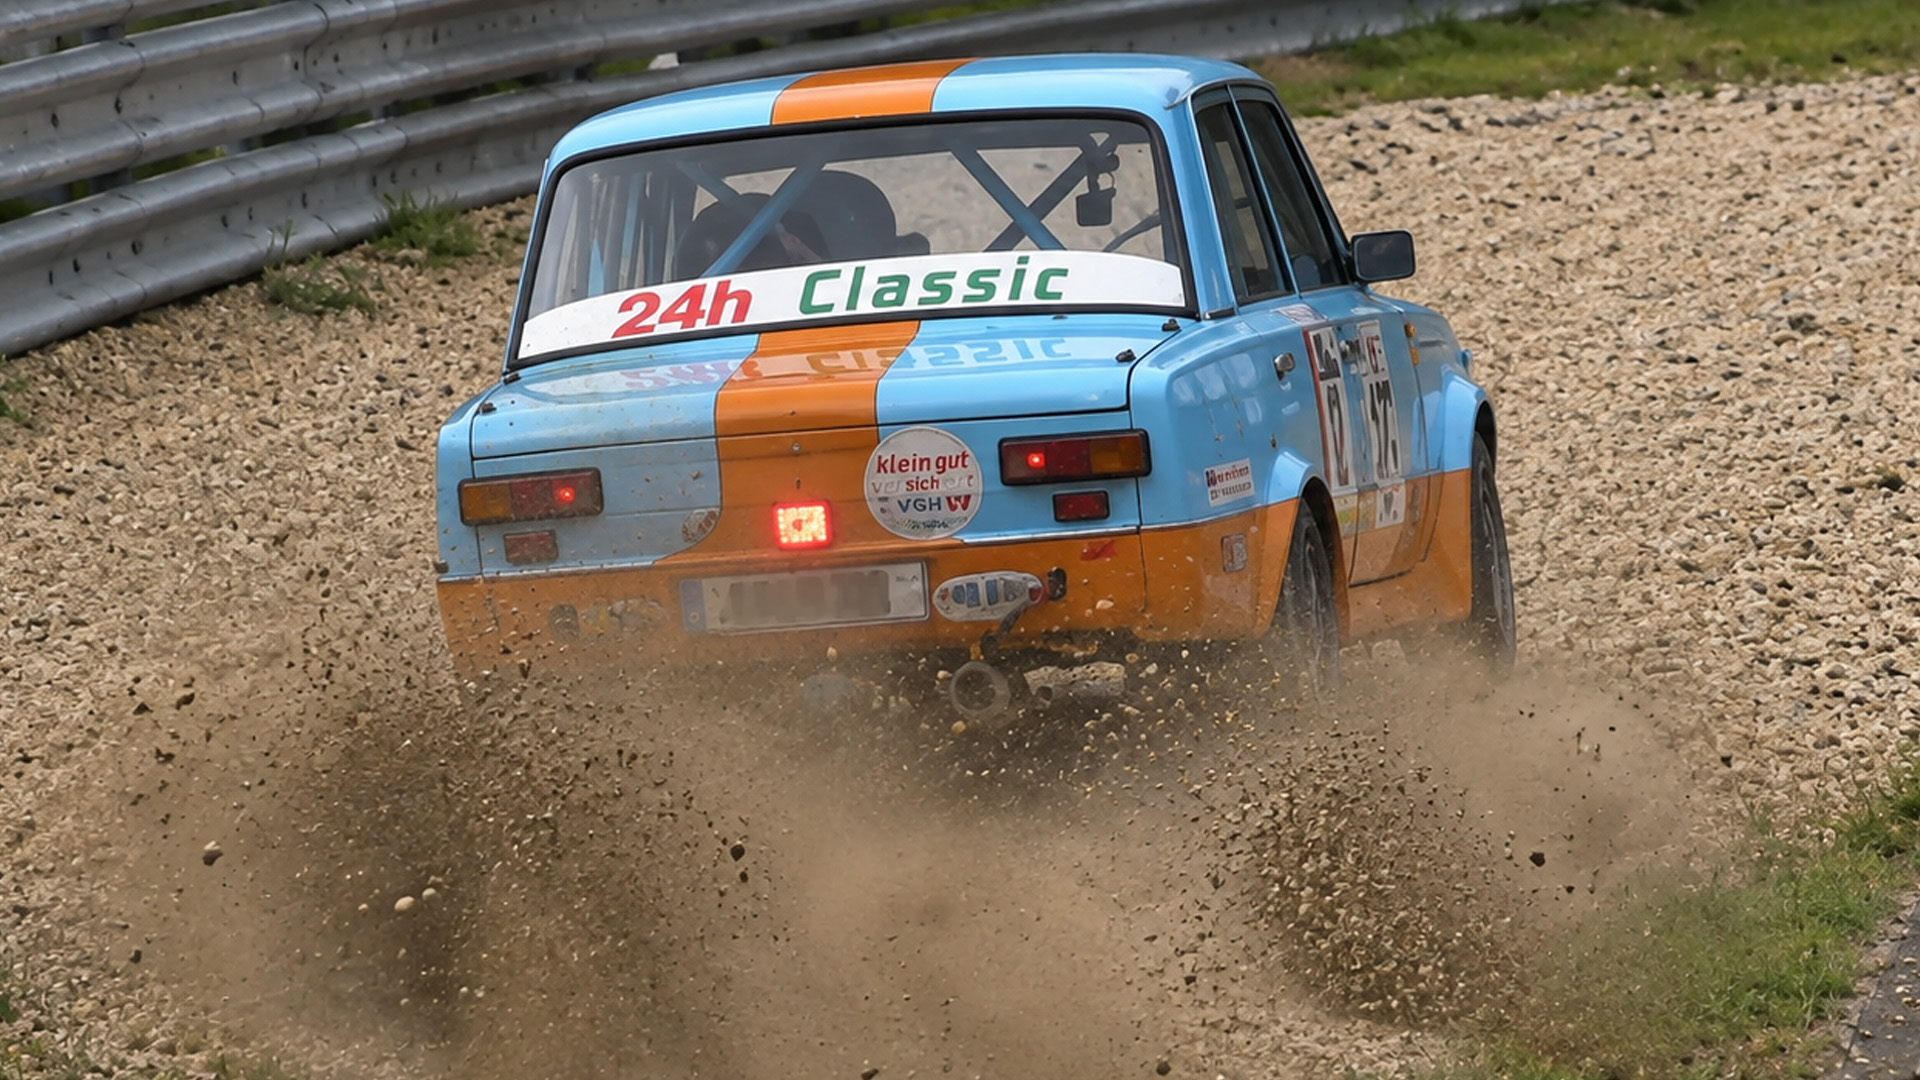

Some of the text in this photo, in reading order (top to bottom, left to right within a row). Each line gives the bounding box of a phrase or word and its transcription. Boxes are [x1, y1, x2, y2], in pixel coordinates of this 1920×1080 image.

[612, 255, 1069, 339] 24h Classic
[876, 450, 969, 475] klein gut
[897, 496, 942, 513] VGH
